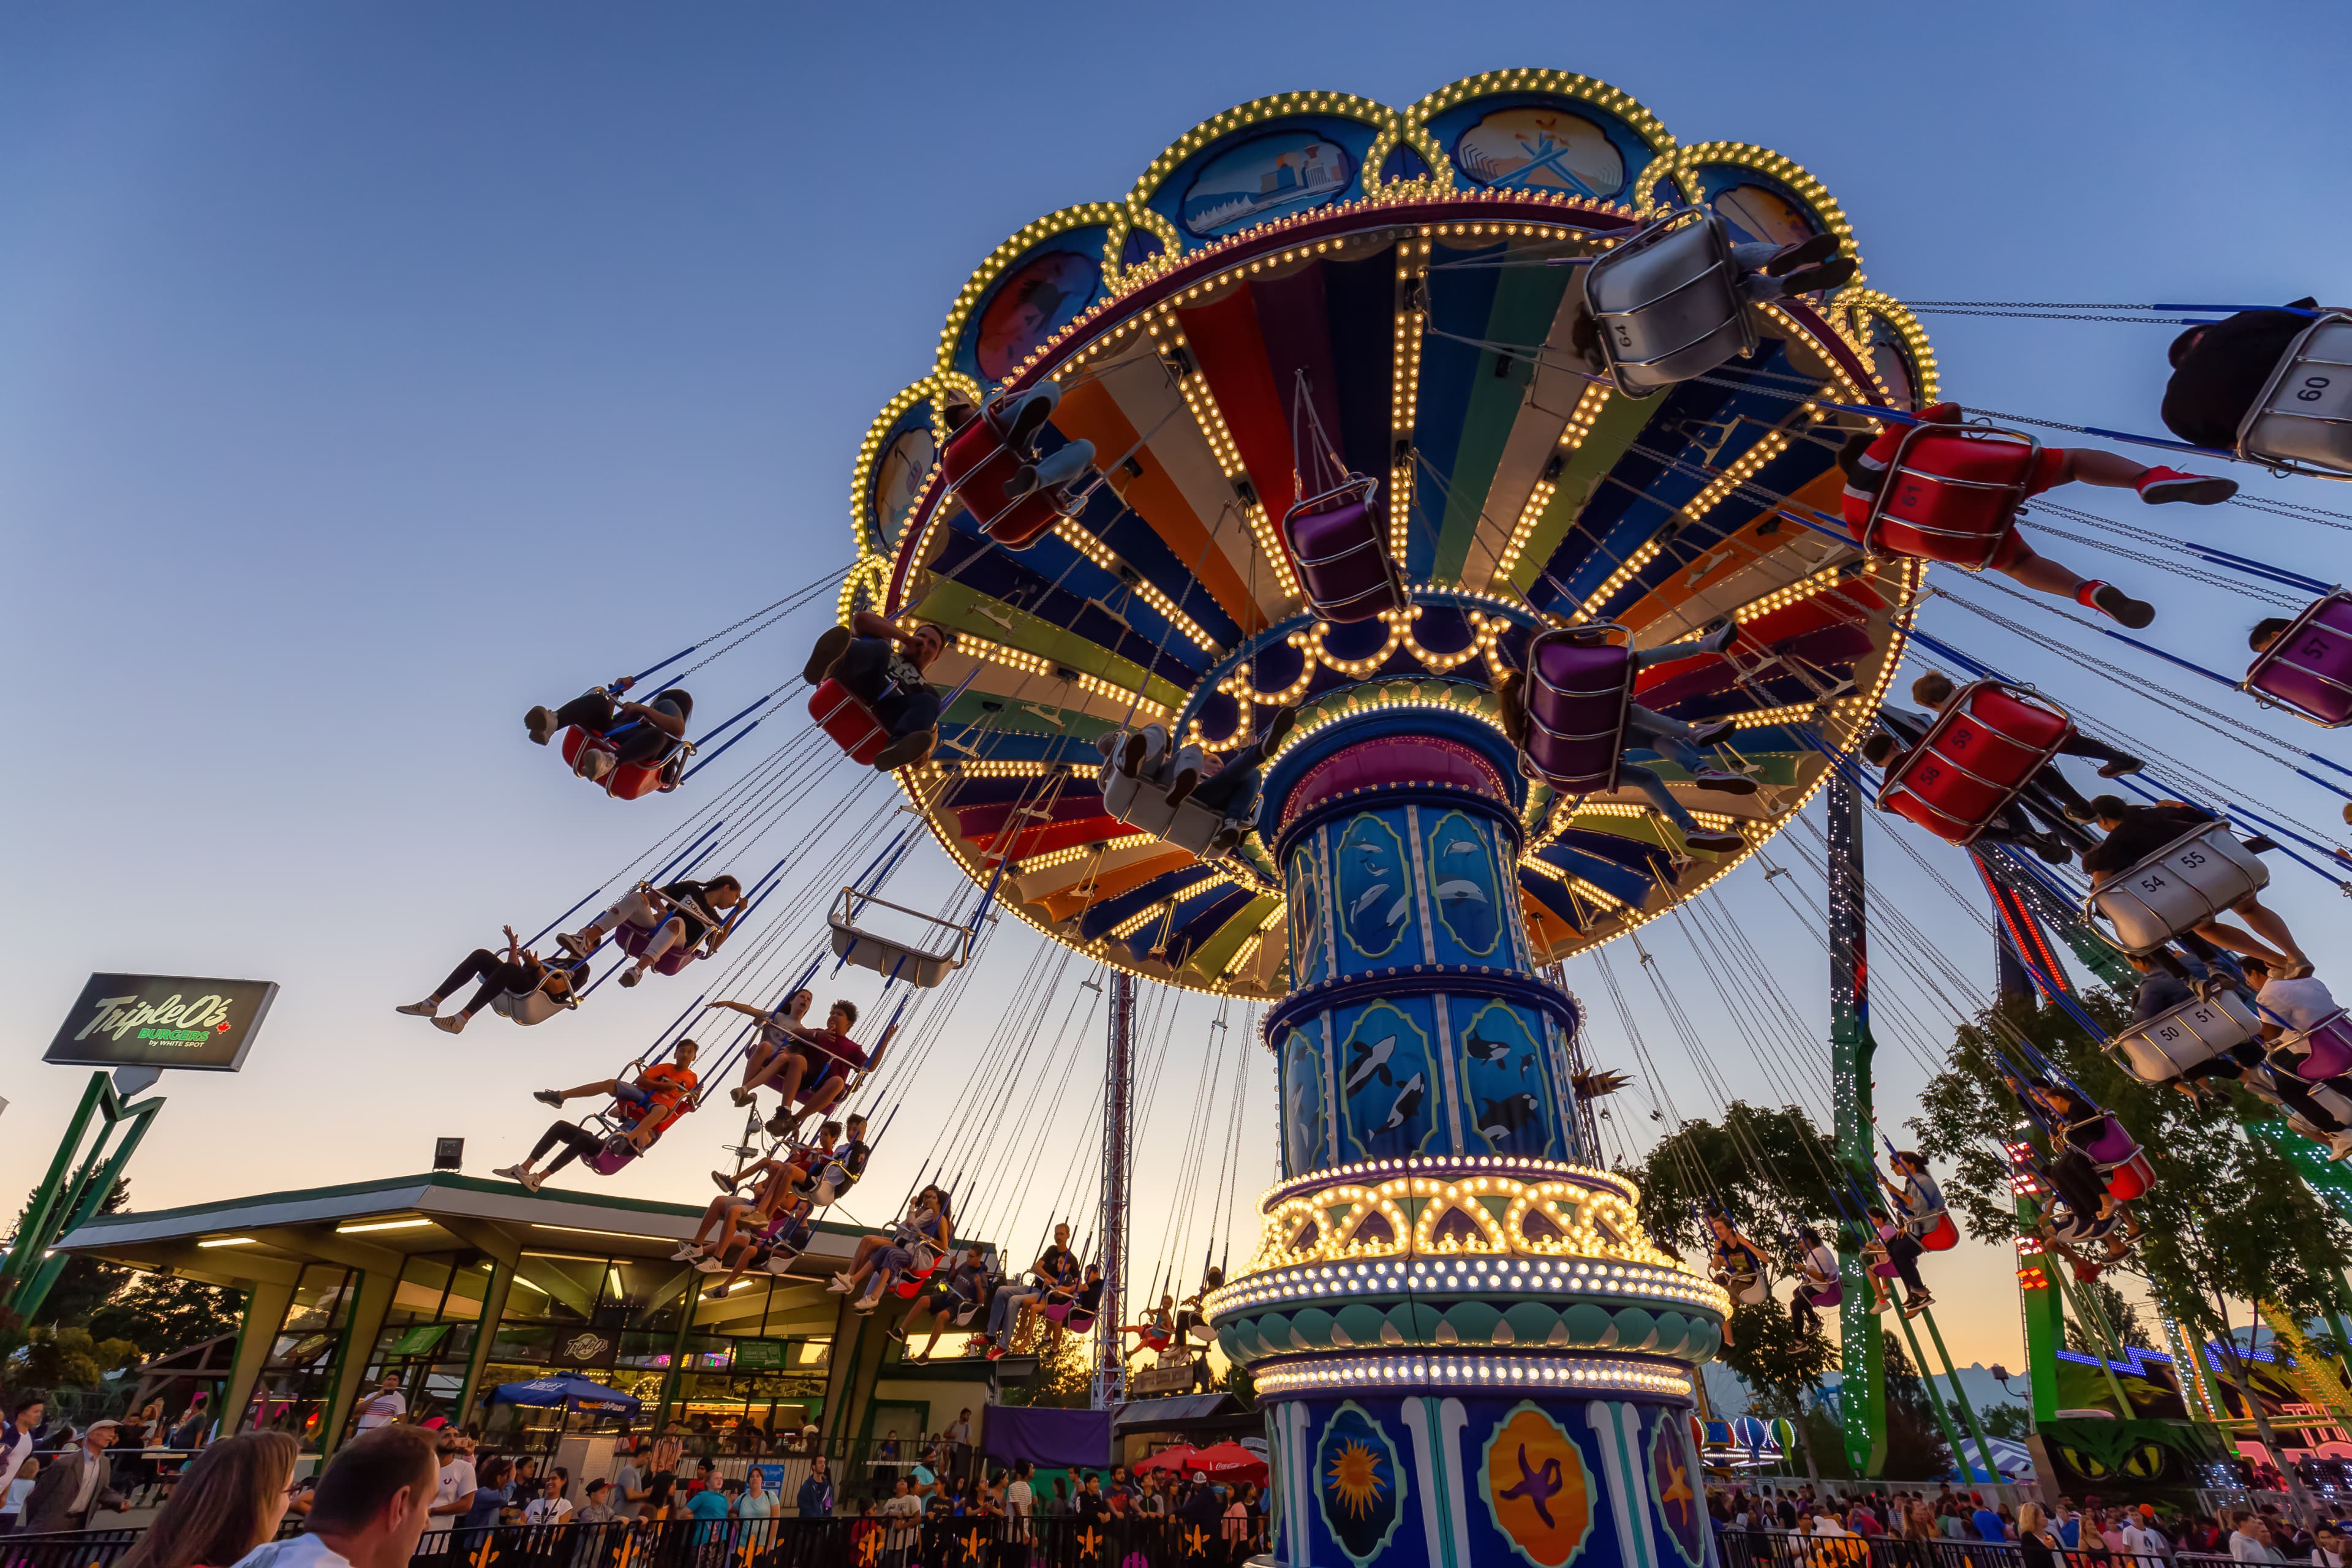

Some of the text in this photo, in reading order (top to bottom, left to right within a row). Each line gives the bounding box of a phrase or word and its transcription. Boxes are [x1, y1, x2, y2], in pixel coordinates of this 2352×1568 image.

[1615, 324, 1632, 348] 64
[2297, 376, 2330, 402] 60
[1901, 485, 1921, 507] 61
[2302, 637, 2330, 660] 57
[1951, 729, 1973, 750] 59
[1920, 766, 1940, 786] 58
[2180, 851, 2206, 869] 55
[2141, 875, 2166, 892] 54
[2195, 1008, 2215, 1023] 51
[137, 1027, 211, 1042] BURGERS
[2160, 1027, 2180, 1041] 50
[159, 1039, 184, 1048] WHITE
[607, 1402, 627, 1412] Pass
